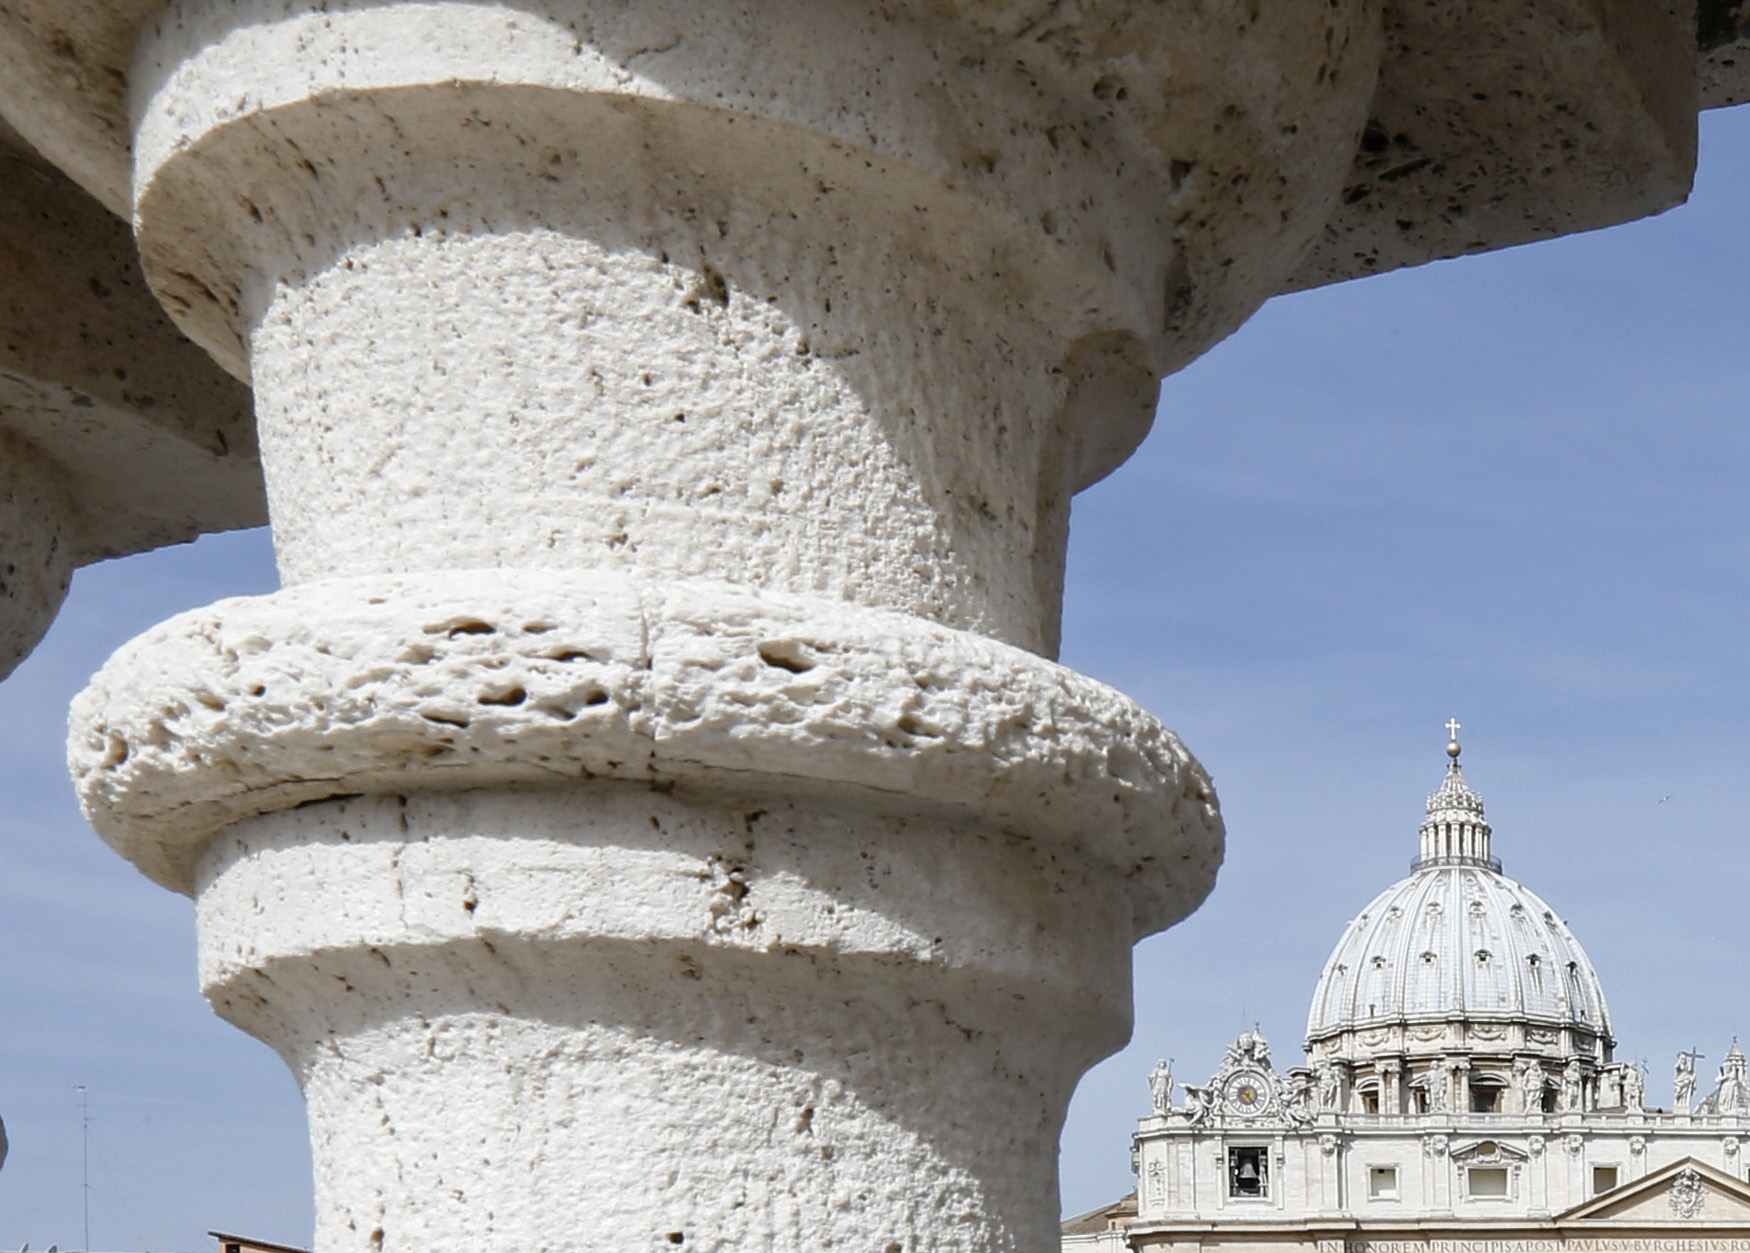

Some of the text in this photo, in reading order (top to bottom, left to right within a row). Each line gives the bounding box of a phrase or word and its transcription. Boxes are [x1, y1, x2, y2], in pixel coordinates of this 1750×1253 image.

[1320, 1241, 1338, 1253] IN
[1345, 1240, 1426, 1253] HONOREM
[1432, 1241, 1512, 1253] PRINCIPIS
[1567, 1239, 1618, 1252] PAVLVS
[1633, 1239, 1730, 1252] BVRGHESIVS
